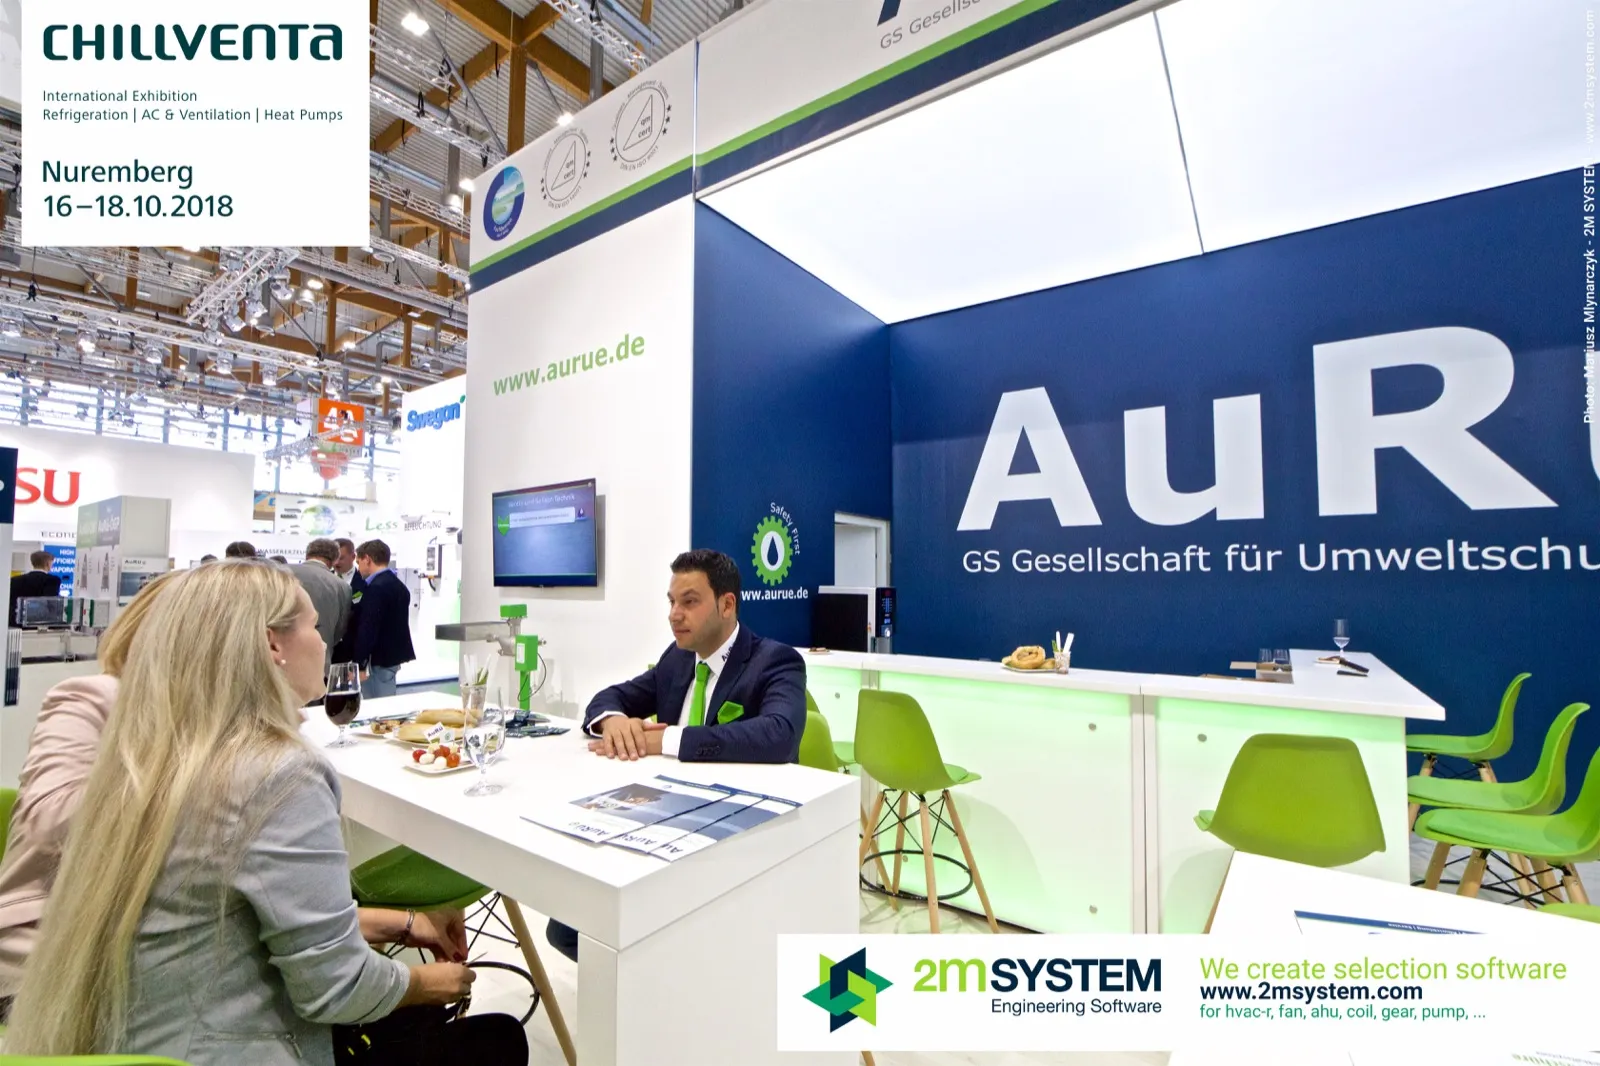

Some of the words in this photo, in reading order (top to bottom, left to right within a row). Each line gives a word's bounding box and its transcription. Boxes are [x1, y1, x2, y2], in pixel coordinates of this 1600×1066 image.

[880, 28, 903, 49] GS
[909, 0, 981, 35] Gesells
[637, 126, 651, 138] cert
[493, 333, 645, 396] www.aurue.de
[407, 402, 460, 432] Swegon
[956, 326, 1600, 530] AuR
[770, 502, 794, 526] Safety
[791, 527, 800, 555] First
[962, 550, 1001, 573] GS
[1011, 545, 1211, 573] Gesellschaft
[1225, 544, 1283, 572] für
[740, 586, 809, 601] ww.aurue.de
